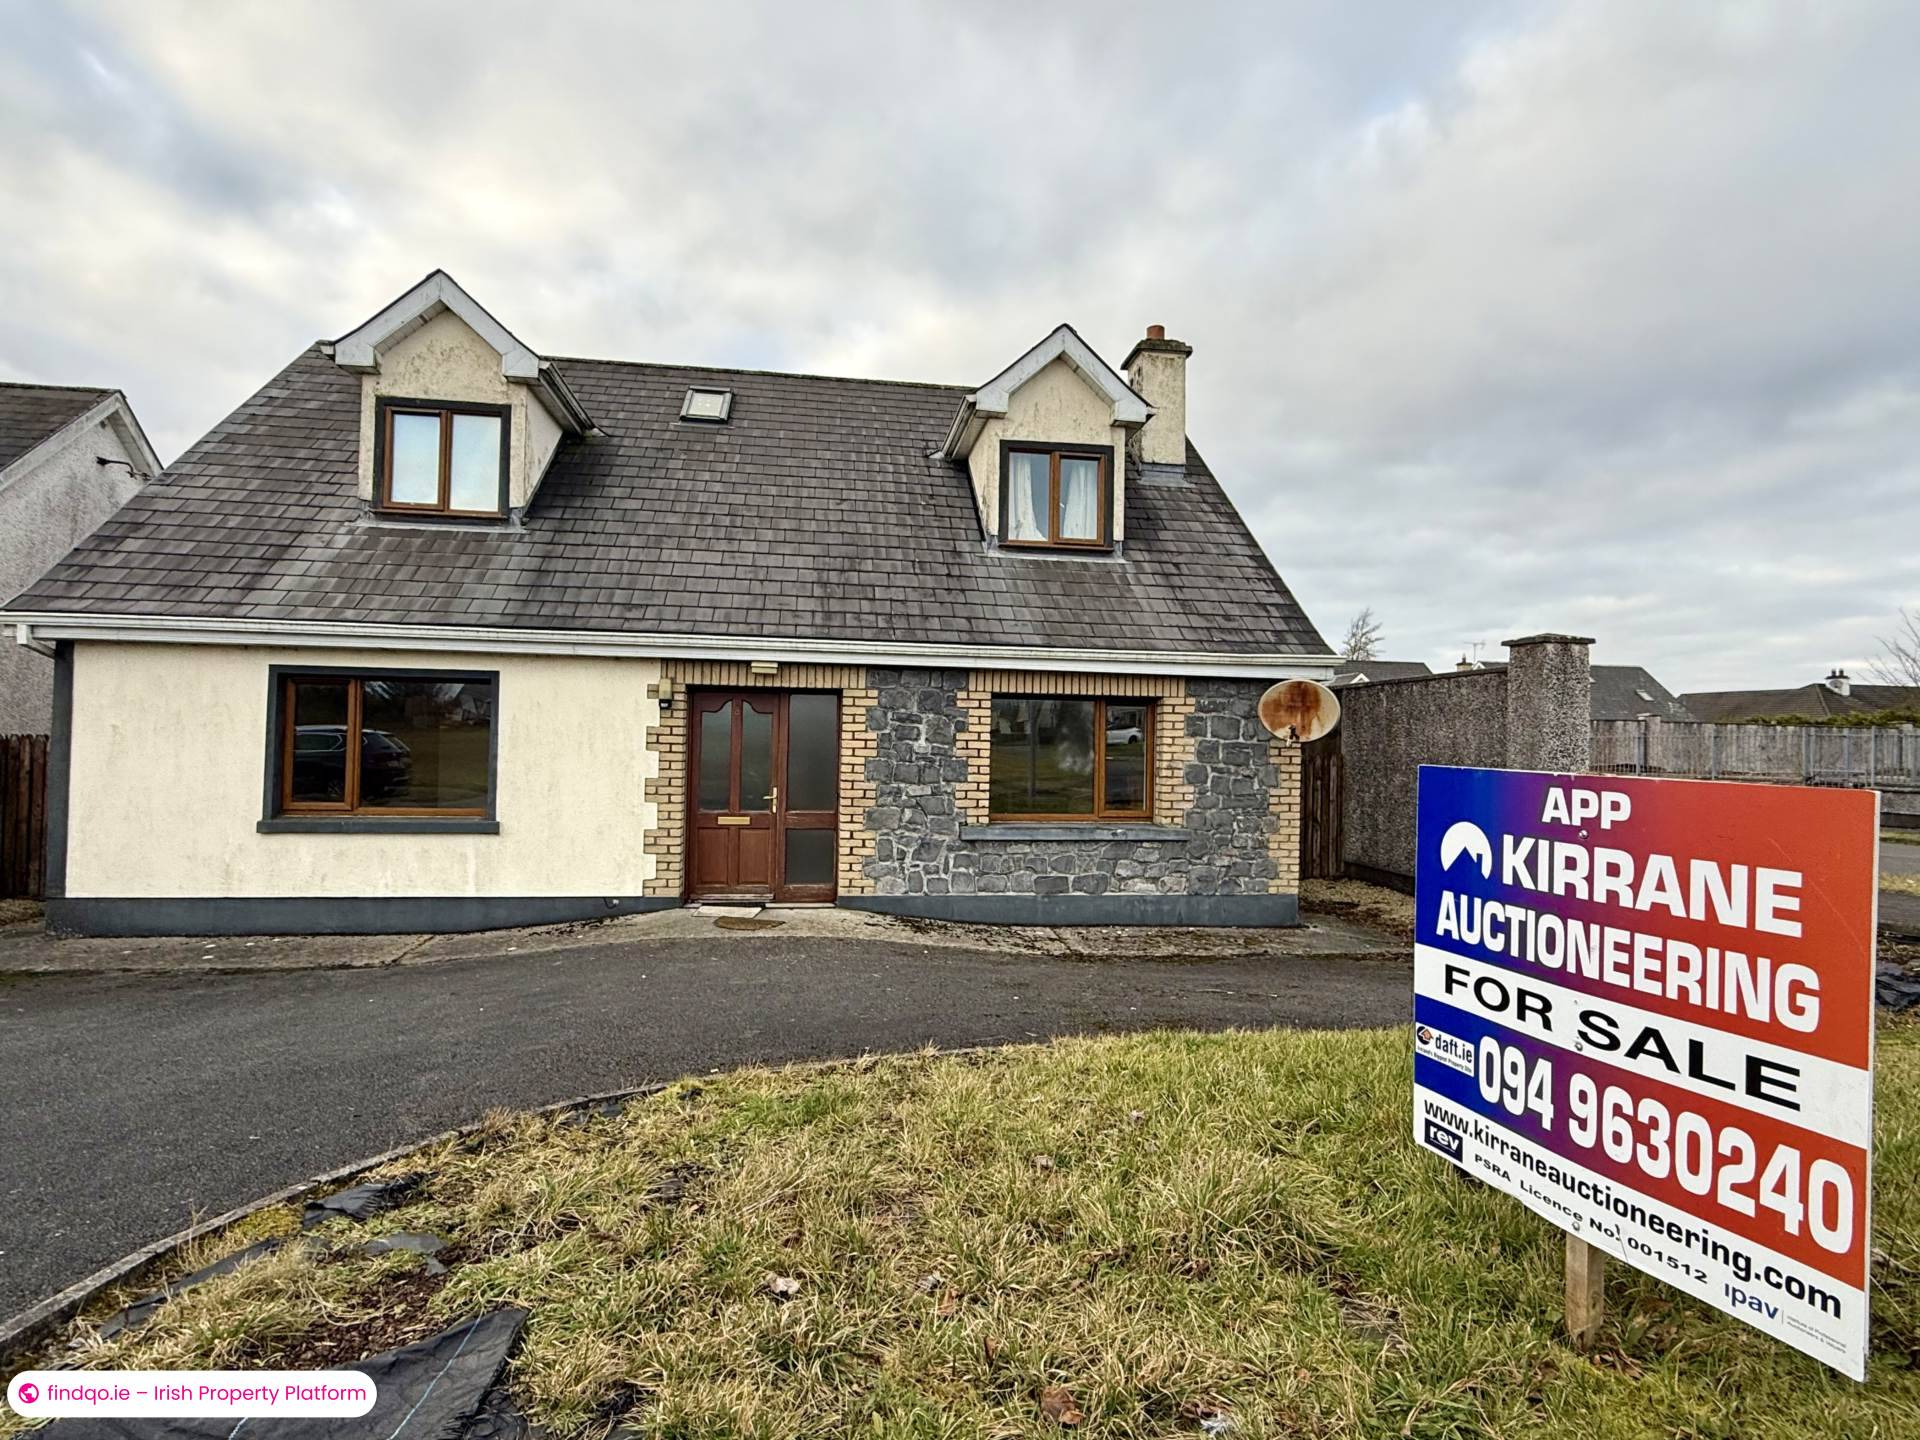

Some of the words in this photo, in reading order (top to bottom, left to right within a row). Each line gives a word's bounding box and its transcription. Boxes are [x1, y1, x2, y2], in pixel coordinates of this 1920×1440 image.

[1542, 788, 1632, 830] APP
[1502, 833, 1803, 938] KIRRANE
[1436, 890, 1821, 1033] AUCTIONEERING
[1435, 1034, 1473, 1064] daft.ie
[1444, 963, 1553, 1032] FOR
[1577, 1009, 1801, 1112] SALE
[1429, 1124, 1460, 1152] rev
[1478, 1035, 1554, 1131] 094
[1568, 1073, 1854, 1254] 9630240
[1424, 1099, 1842, 1320] www.kirraneauctioneering.com
[1474, 1153, 1512, 1182] PSRA
[1520, 1179, 1583, 1223] Licence
[1627, 1236, 1708, 1285] 001512
